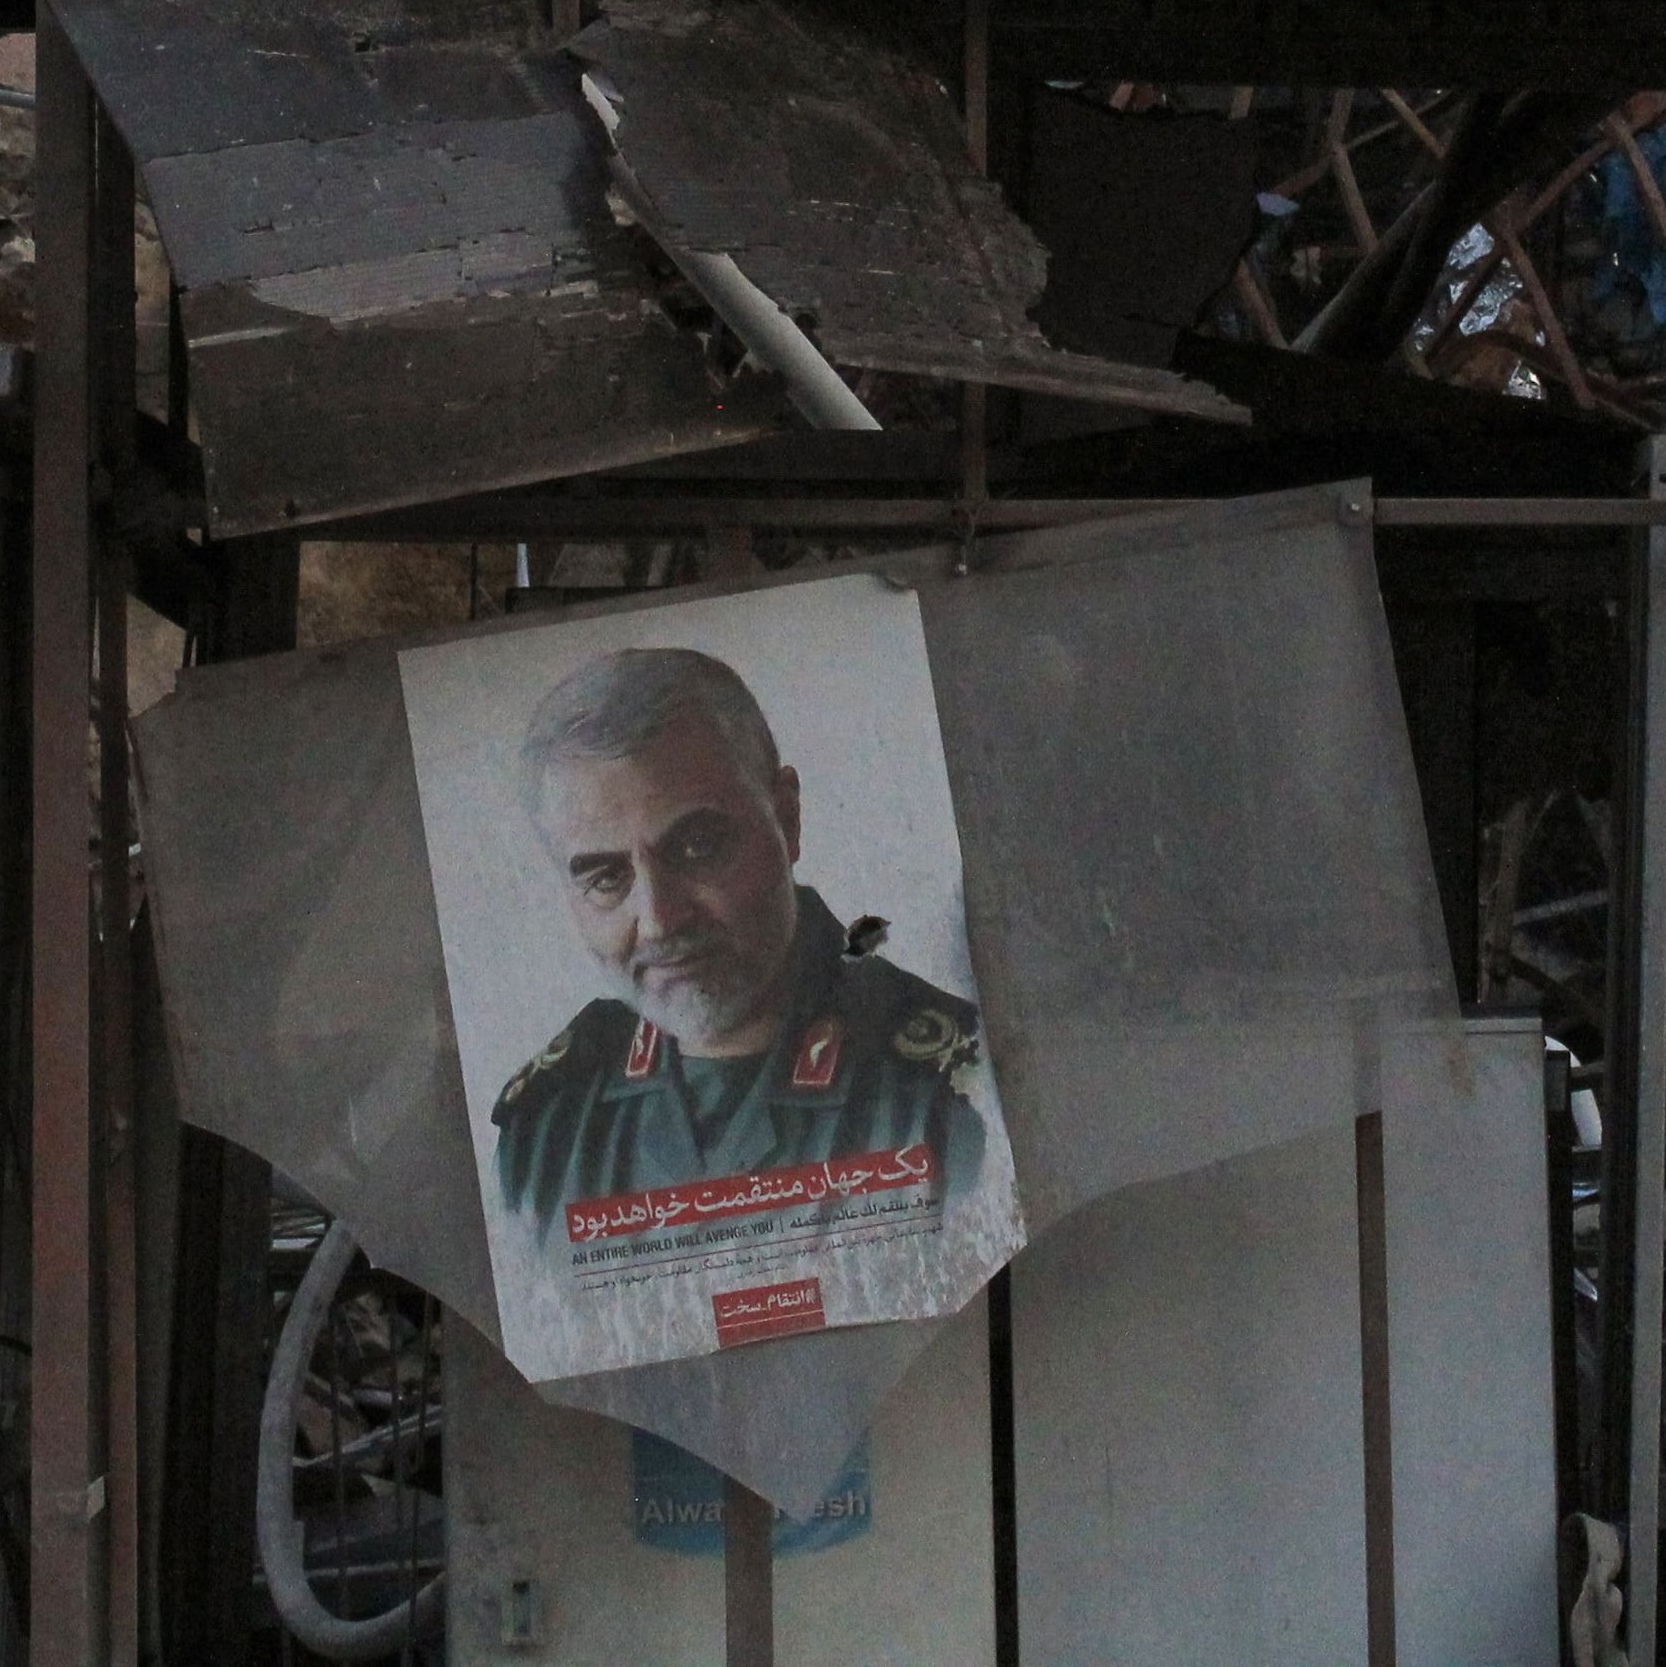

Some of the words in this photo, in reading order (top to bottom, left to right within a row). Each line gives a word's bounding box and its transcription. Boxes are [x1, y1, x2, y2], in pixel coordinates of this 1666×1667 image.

[807, 1161, 874, 1201] جهان
[878, 1144, 929, 1183] یک
[610, 1192, 690, 1230] خواهد
[694, 1175, 804, 1213] منتقمت
[572, 1212, 608, 1242] بود
[572, 1253, 587, 1265] AN
[591, 1247, 629, 1262] ENTIRE
[631, 1240, 671, 1255] WORLD
[675, 1234, 702, 1248] WILL
[705, 1225, 750, 1242] AVENGE
[752, 1220, 774, 1234] YOU
[641, 1496, 722, 1524] Alwa
